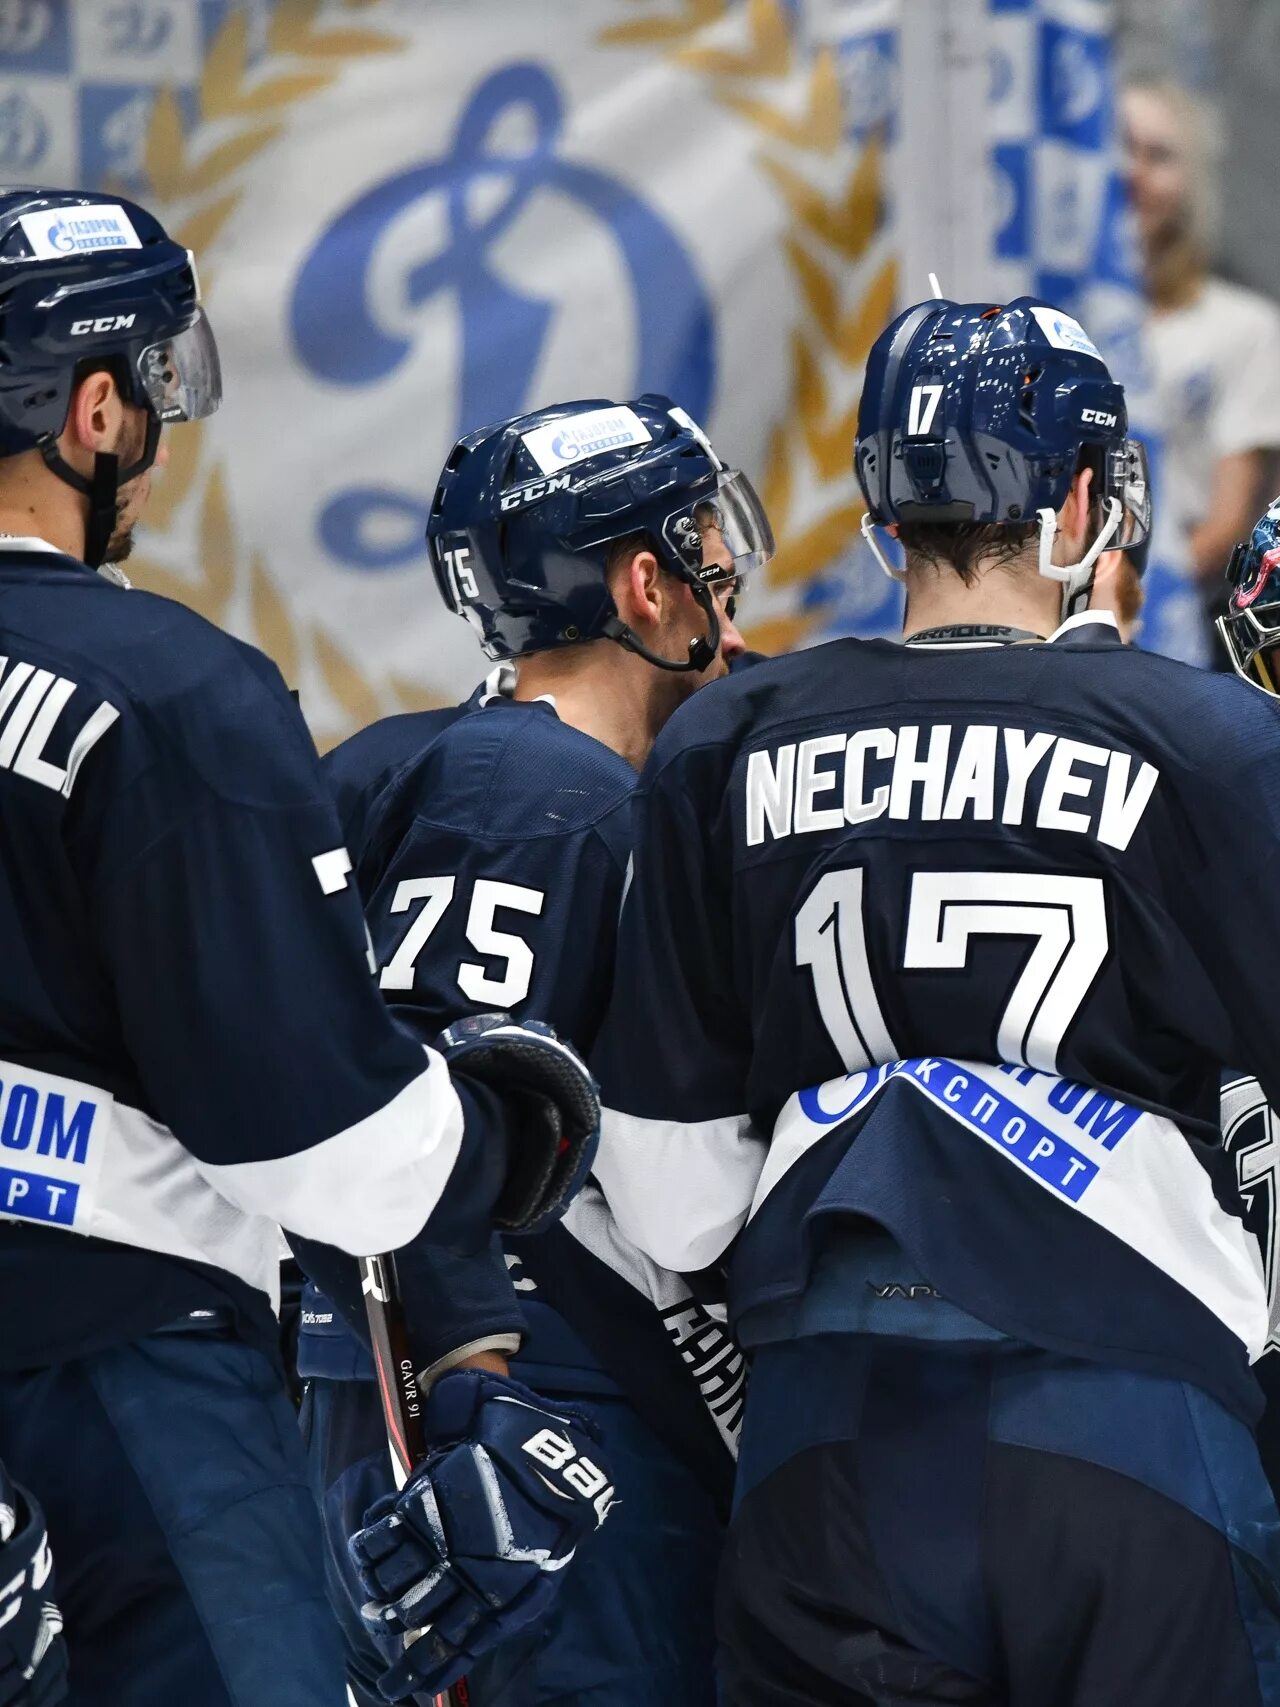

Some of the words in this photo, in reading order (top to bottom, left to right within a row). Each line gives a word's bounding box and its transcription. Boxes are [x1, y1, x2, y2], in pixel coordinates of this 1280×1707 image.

[70, 313, 136, 336] CCM
[908, 384, 944, 436] 17
[1080, 408, 1117, 428] CCM
[500, 474, 571, 511] CCM
[444, 547, 480, 601] 75
[746, 724, 1159, 853] NECHAYEV
[378, 876, 544, 1008] 75
[795, 867, 1109, 1075] 17
[401, 1359, 418, 1400] GAVR
[408, 1403, 420, 1418] 91
